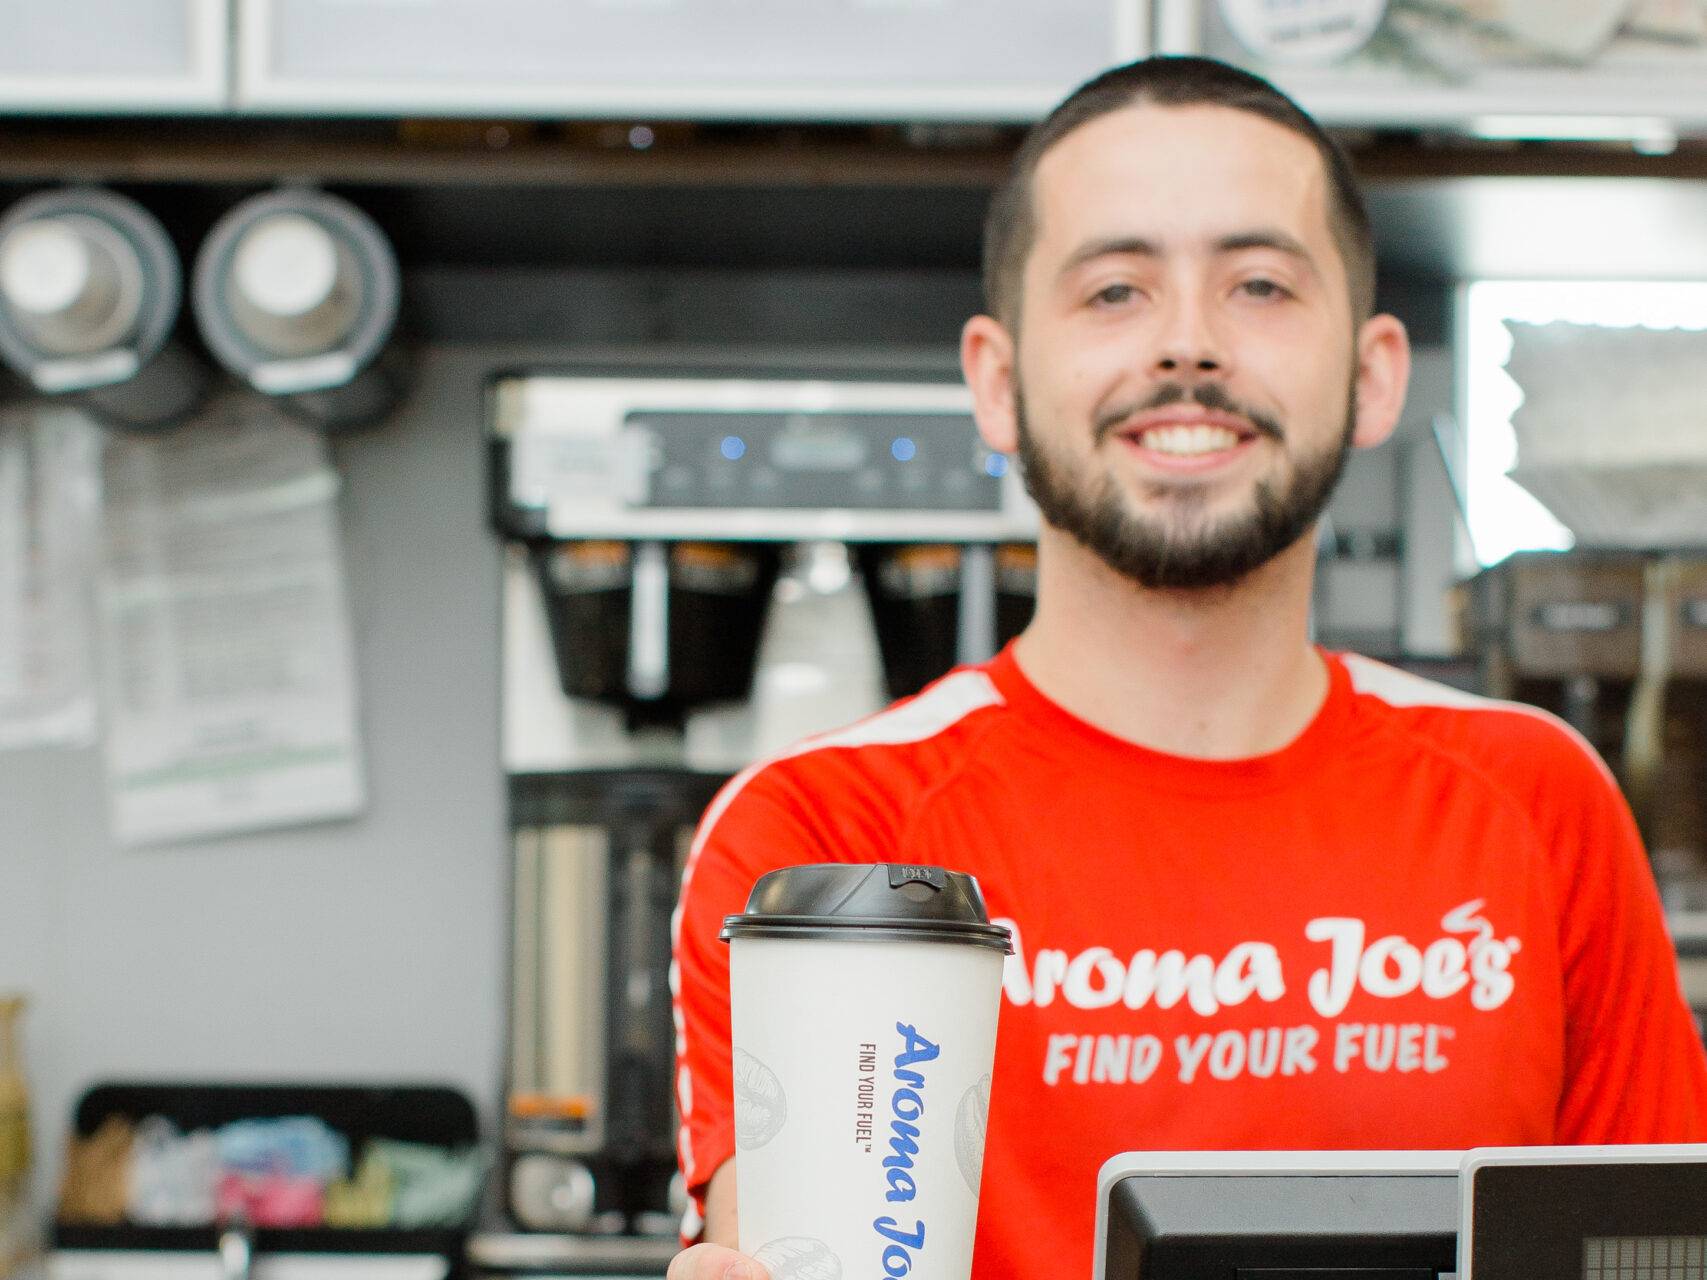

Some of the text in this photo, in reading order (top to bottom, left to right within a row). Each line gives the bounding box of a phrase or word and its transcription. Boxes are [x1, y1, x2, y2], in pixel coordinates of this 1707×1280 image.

[859, 1043, 876, 1072] FIND
[1044, 1034, 1163, 1085] FIND
[1174, 1025, 1319, 1084] YOUR
[857, 1076, 875, 1109] YOUR
[882, 1021, 940, 1202] Aroma
